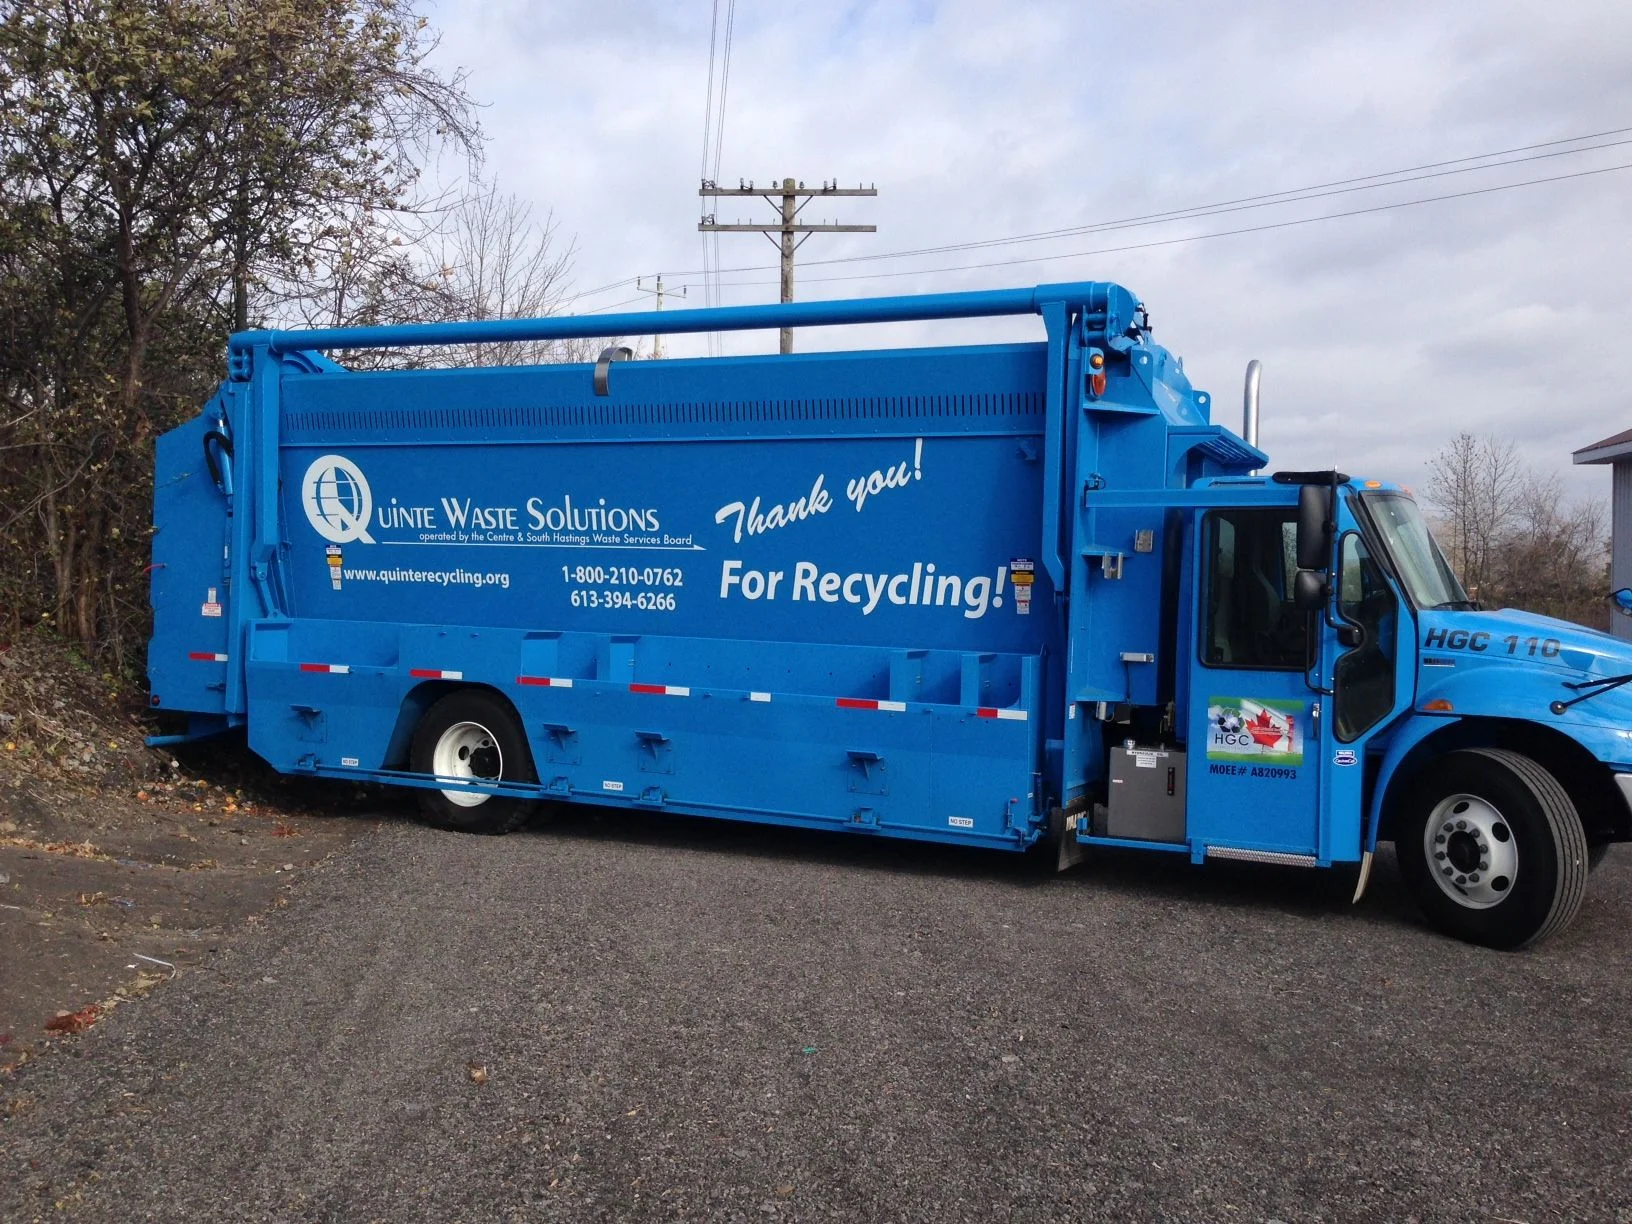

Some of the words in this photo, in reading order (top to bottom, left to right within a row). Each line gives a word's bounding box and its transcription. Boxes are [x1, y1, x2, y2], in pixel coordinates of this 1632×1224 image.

[715, 474, 833, 543] Thank
[847, 438, 923, 512] you!
[440, 497, 519, 529] WASTE
[419, 530, 456, 543] operated
[458, 530, 469, 543] by
[471, 531, 484, 541] the
[486, 531, 514, 542] Centre
[517, 531, 524, 541] &
[526, 532, 550, 542] South
[553, 533, 590, 545] Hastings
[592, 534, 620, 544] Waste
[623, 534, 661, 545] Services
[663, 534, 692, 545] Board
[343, 567, 510, 588] www.quinterecycling.org
[562, 565, 683, 586] 1-800-210-0762
[720, 560, 784, 600] For
[792, 562, 1007, 619] Recycling!
[570, 590, 676, 611] 613-394-6266
[1424, 627, 1490, 652] HGC
[1503, 635, 1561, 658] 110
[1215, 733, 1249, 746] HGC
[1250, 767, 1297, 780] A820993
